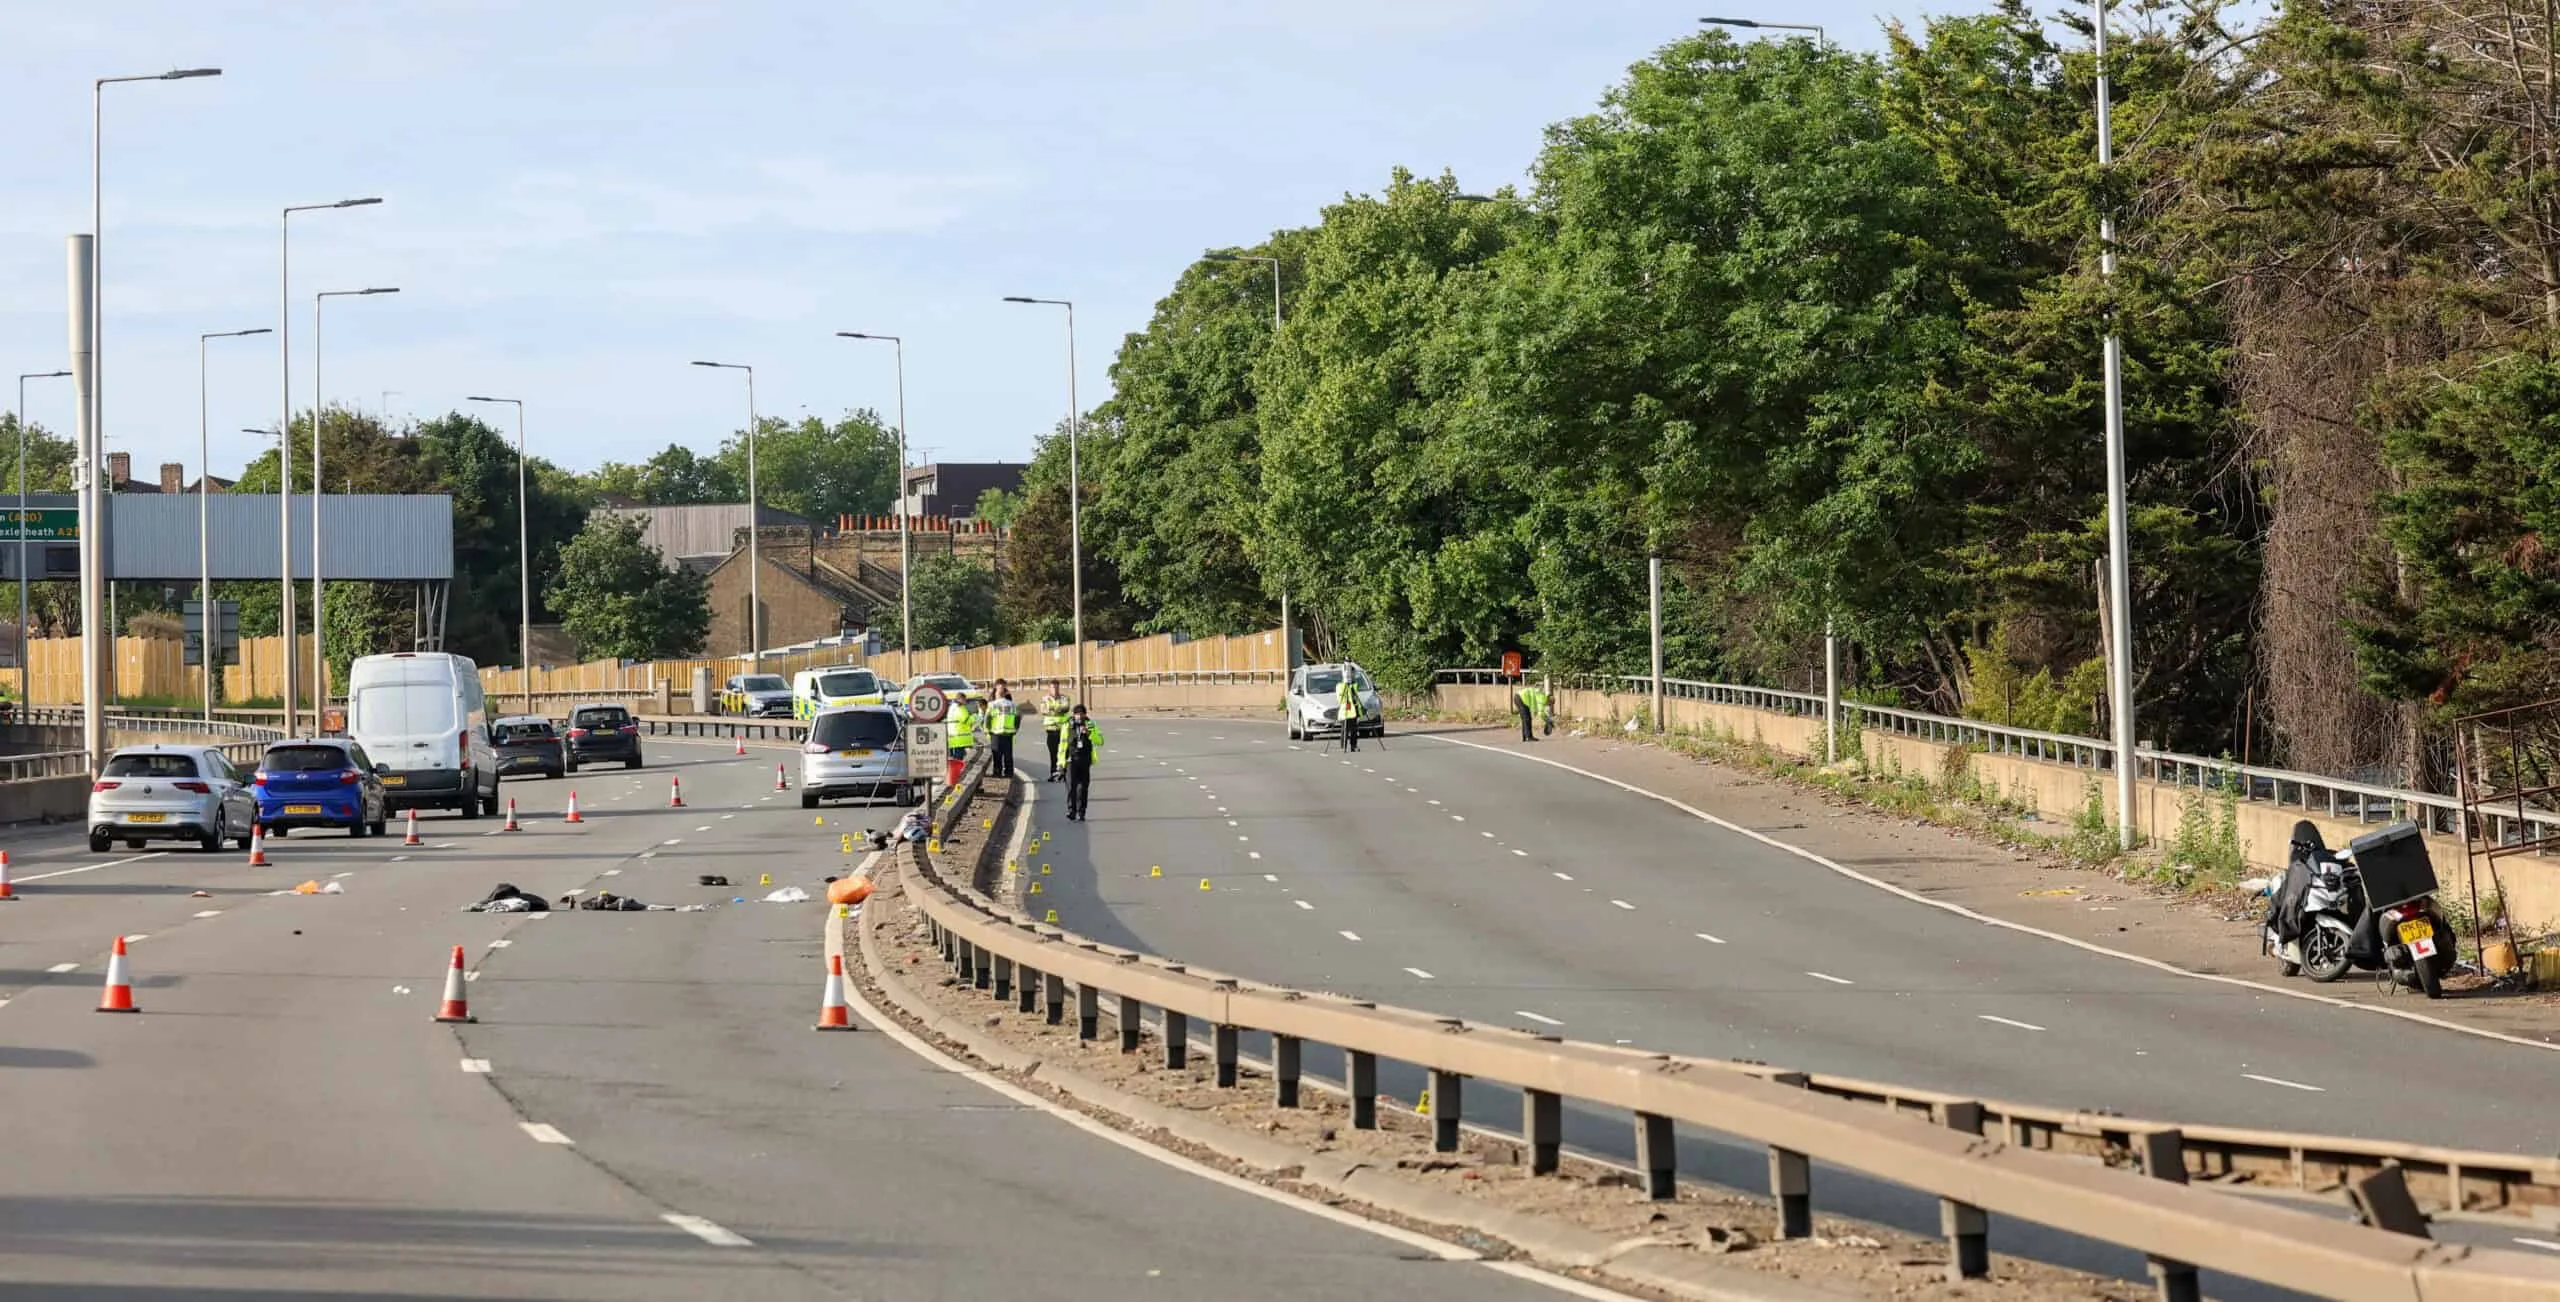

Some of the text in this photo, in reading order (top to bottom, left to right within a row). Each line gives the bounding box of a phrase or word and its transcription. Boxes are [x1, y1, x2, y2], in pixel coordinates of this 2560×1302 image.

[915, 695, 941, 712] 50
[911, 748, 944, 758] Average
[2415, 941, 2429, 954] L
